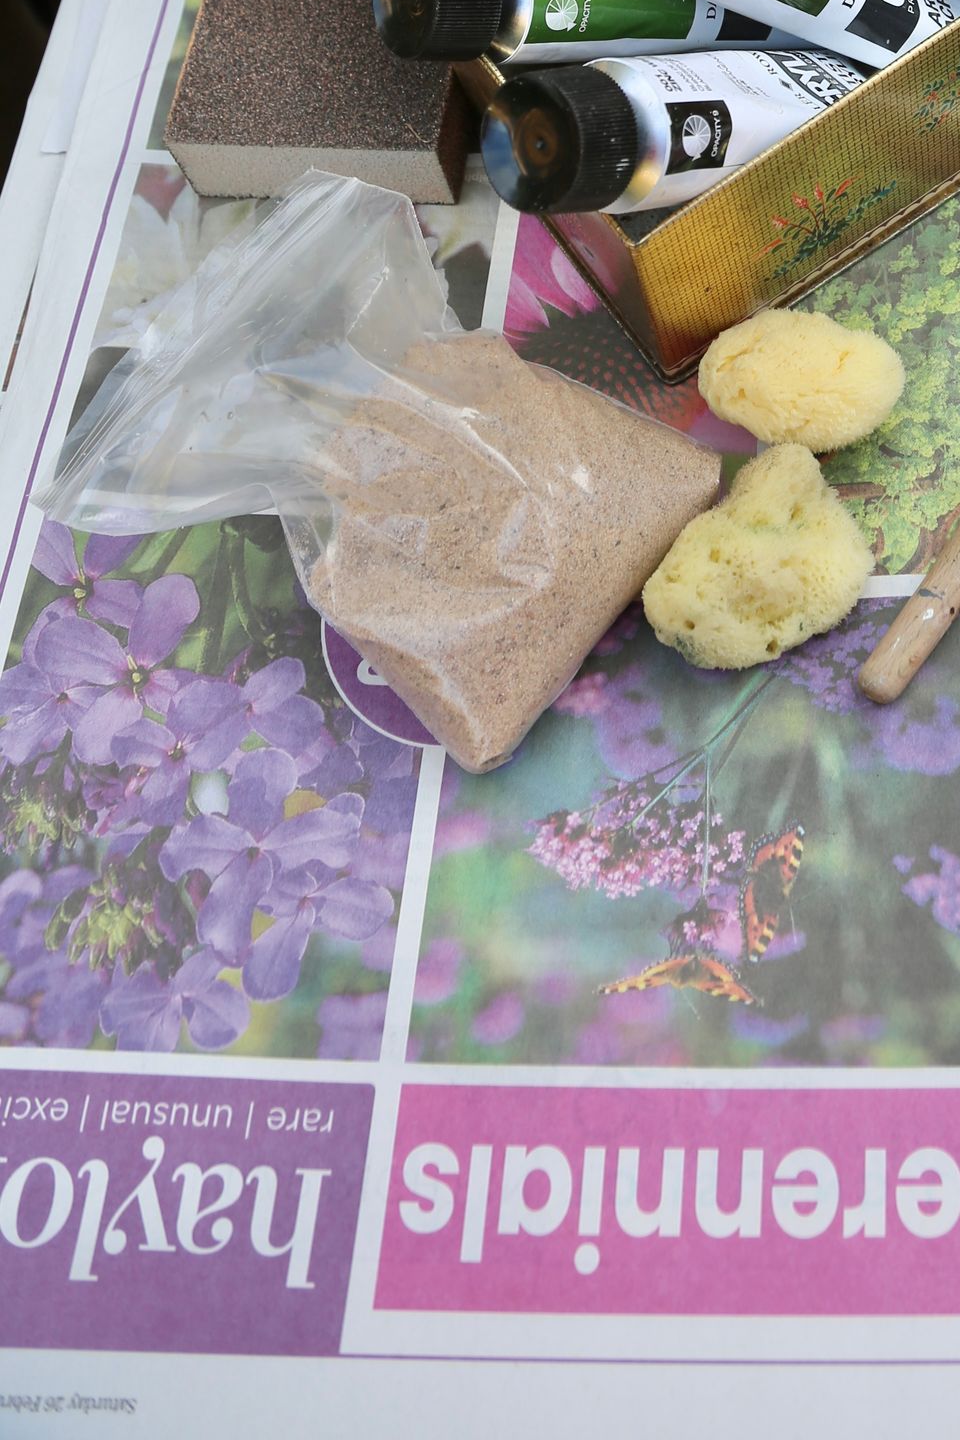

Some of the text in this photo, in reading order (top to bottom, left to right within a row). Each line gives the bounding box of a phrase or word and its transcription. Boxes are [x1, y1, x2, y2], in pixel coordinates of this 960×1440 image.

[711, 117, 723, 158] OPACITY
[101, 1100, 232, 1131] unusual
[267, 1106, 334, 1133] rare
[0, 1136, 332, 1289] haylo
[43, 1396, 65, 1413] 26
[68, 1393, 137, 1415] Saturday
